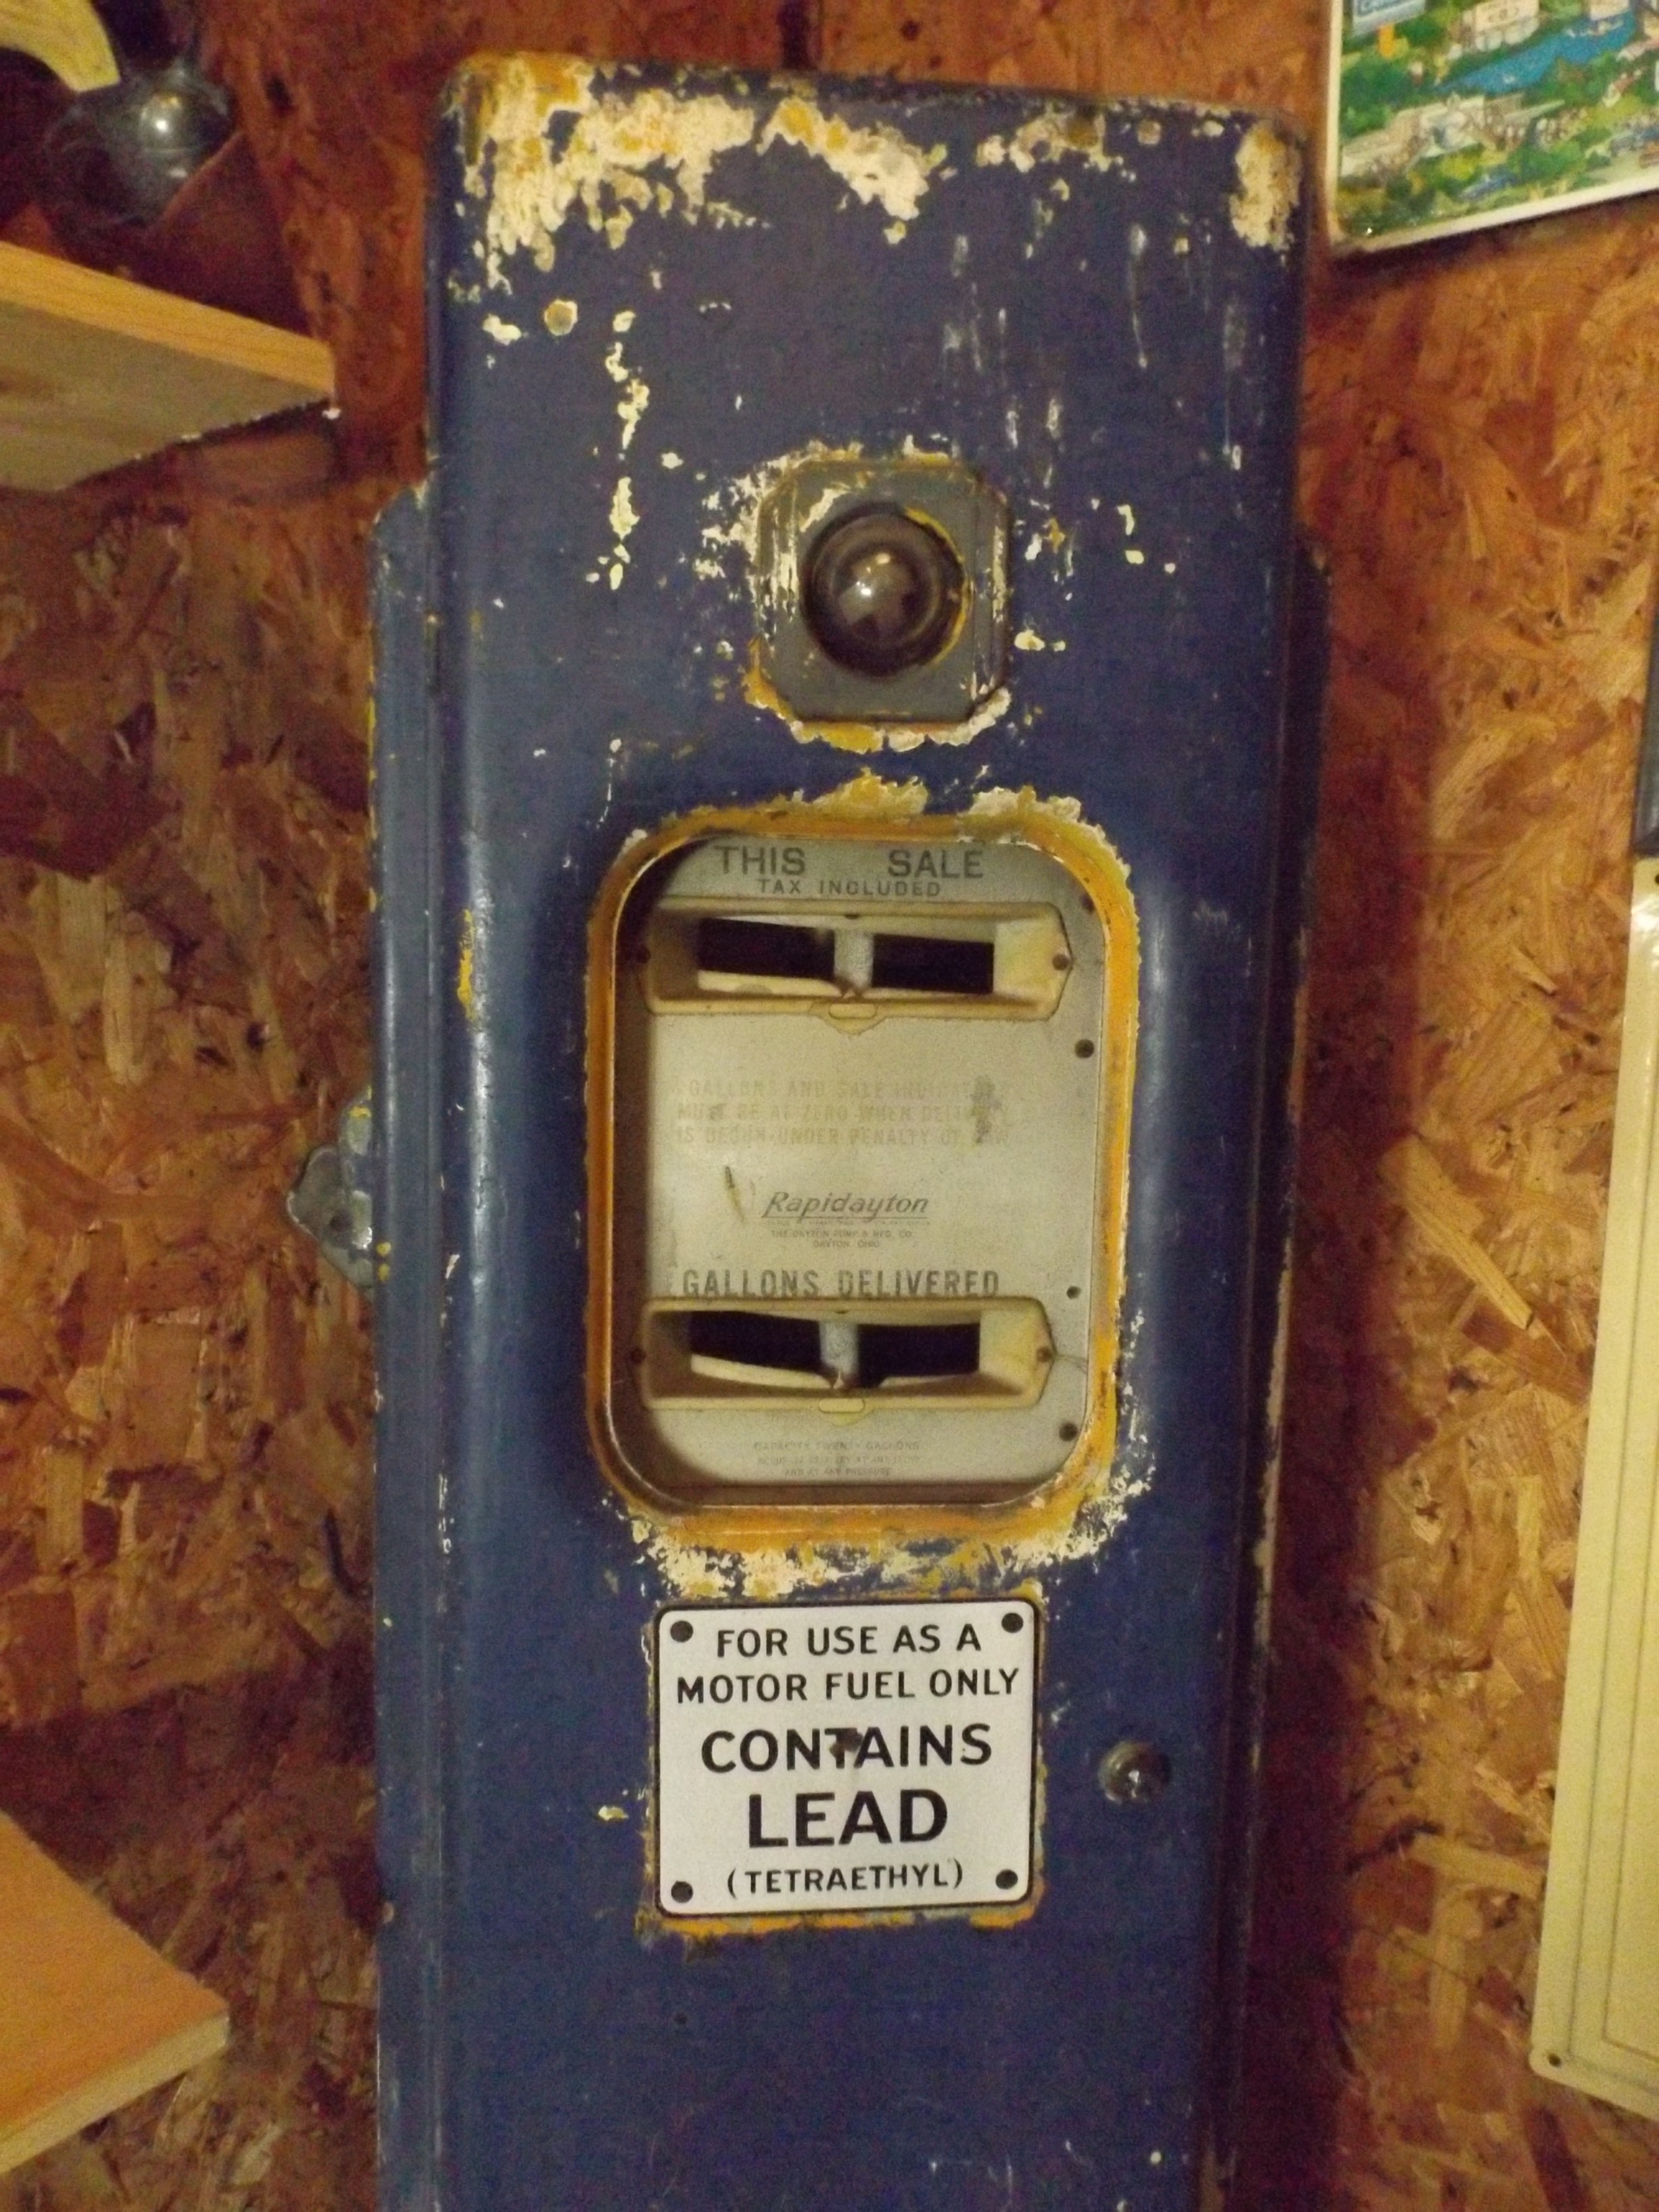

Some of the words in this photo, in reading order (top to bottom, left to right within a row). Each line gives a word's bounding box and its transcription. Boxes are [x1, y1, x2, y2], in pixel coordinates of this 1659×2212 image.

[714, 846, 805, 875] THIS
[888, 849, 984, 878] SALE
[758, 878, 800, 894] TAX
[820, 880, 941, 897] INCLUDED
[761, 1191, 929, 1223] Rapidayton
[683, 1269, 820, 1298] GALLONS
[838, 1270, 1000, 1297] DELIVERED
[717, 1628, 788, 1658] FOR
[808, 1626, 878, 1655] USE
[893, 1624, 941, 1653] AS
[956, 1623, 981, 1651] A
[677, 1674, 807, 1704] MOTOR
[826, 1670, 915, 1700] FUEL
[929, 1667, 1019, 1697] ONLY
[701, 1723, 992, 1773] CONTAINS
[749, 1788, 948, 1849] LEAD
[727, 1858, 963, 1900] (TETRAETHYL)
